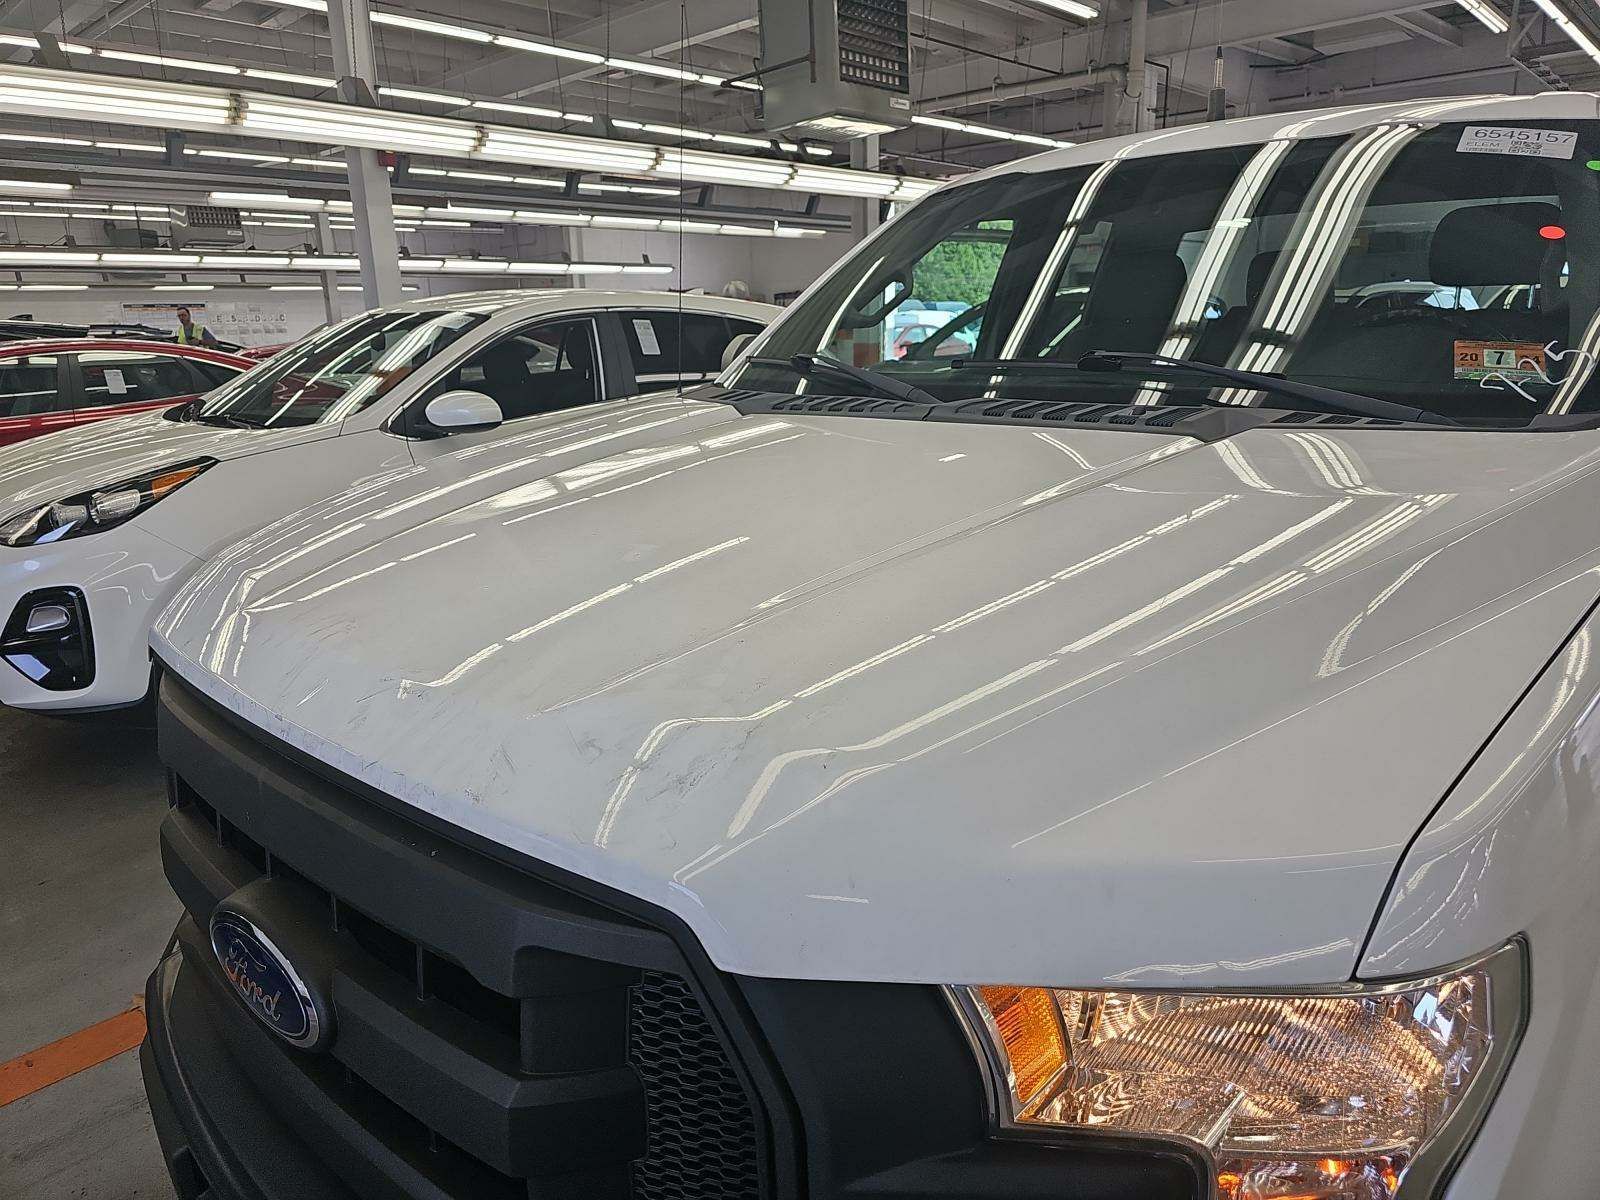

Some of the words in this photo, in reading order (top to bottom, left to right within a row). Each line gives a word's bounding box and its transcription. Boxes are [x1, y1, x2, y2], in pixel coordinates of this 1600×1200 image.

[1474, 128, 1574, 144] 6545157
[1459, 352, 1479, 362] 20
[1493, 350, 1505, 365] 7
[224, 938, 282, 1022] Ford
